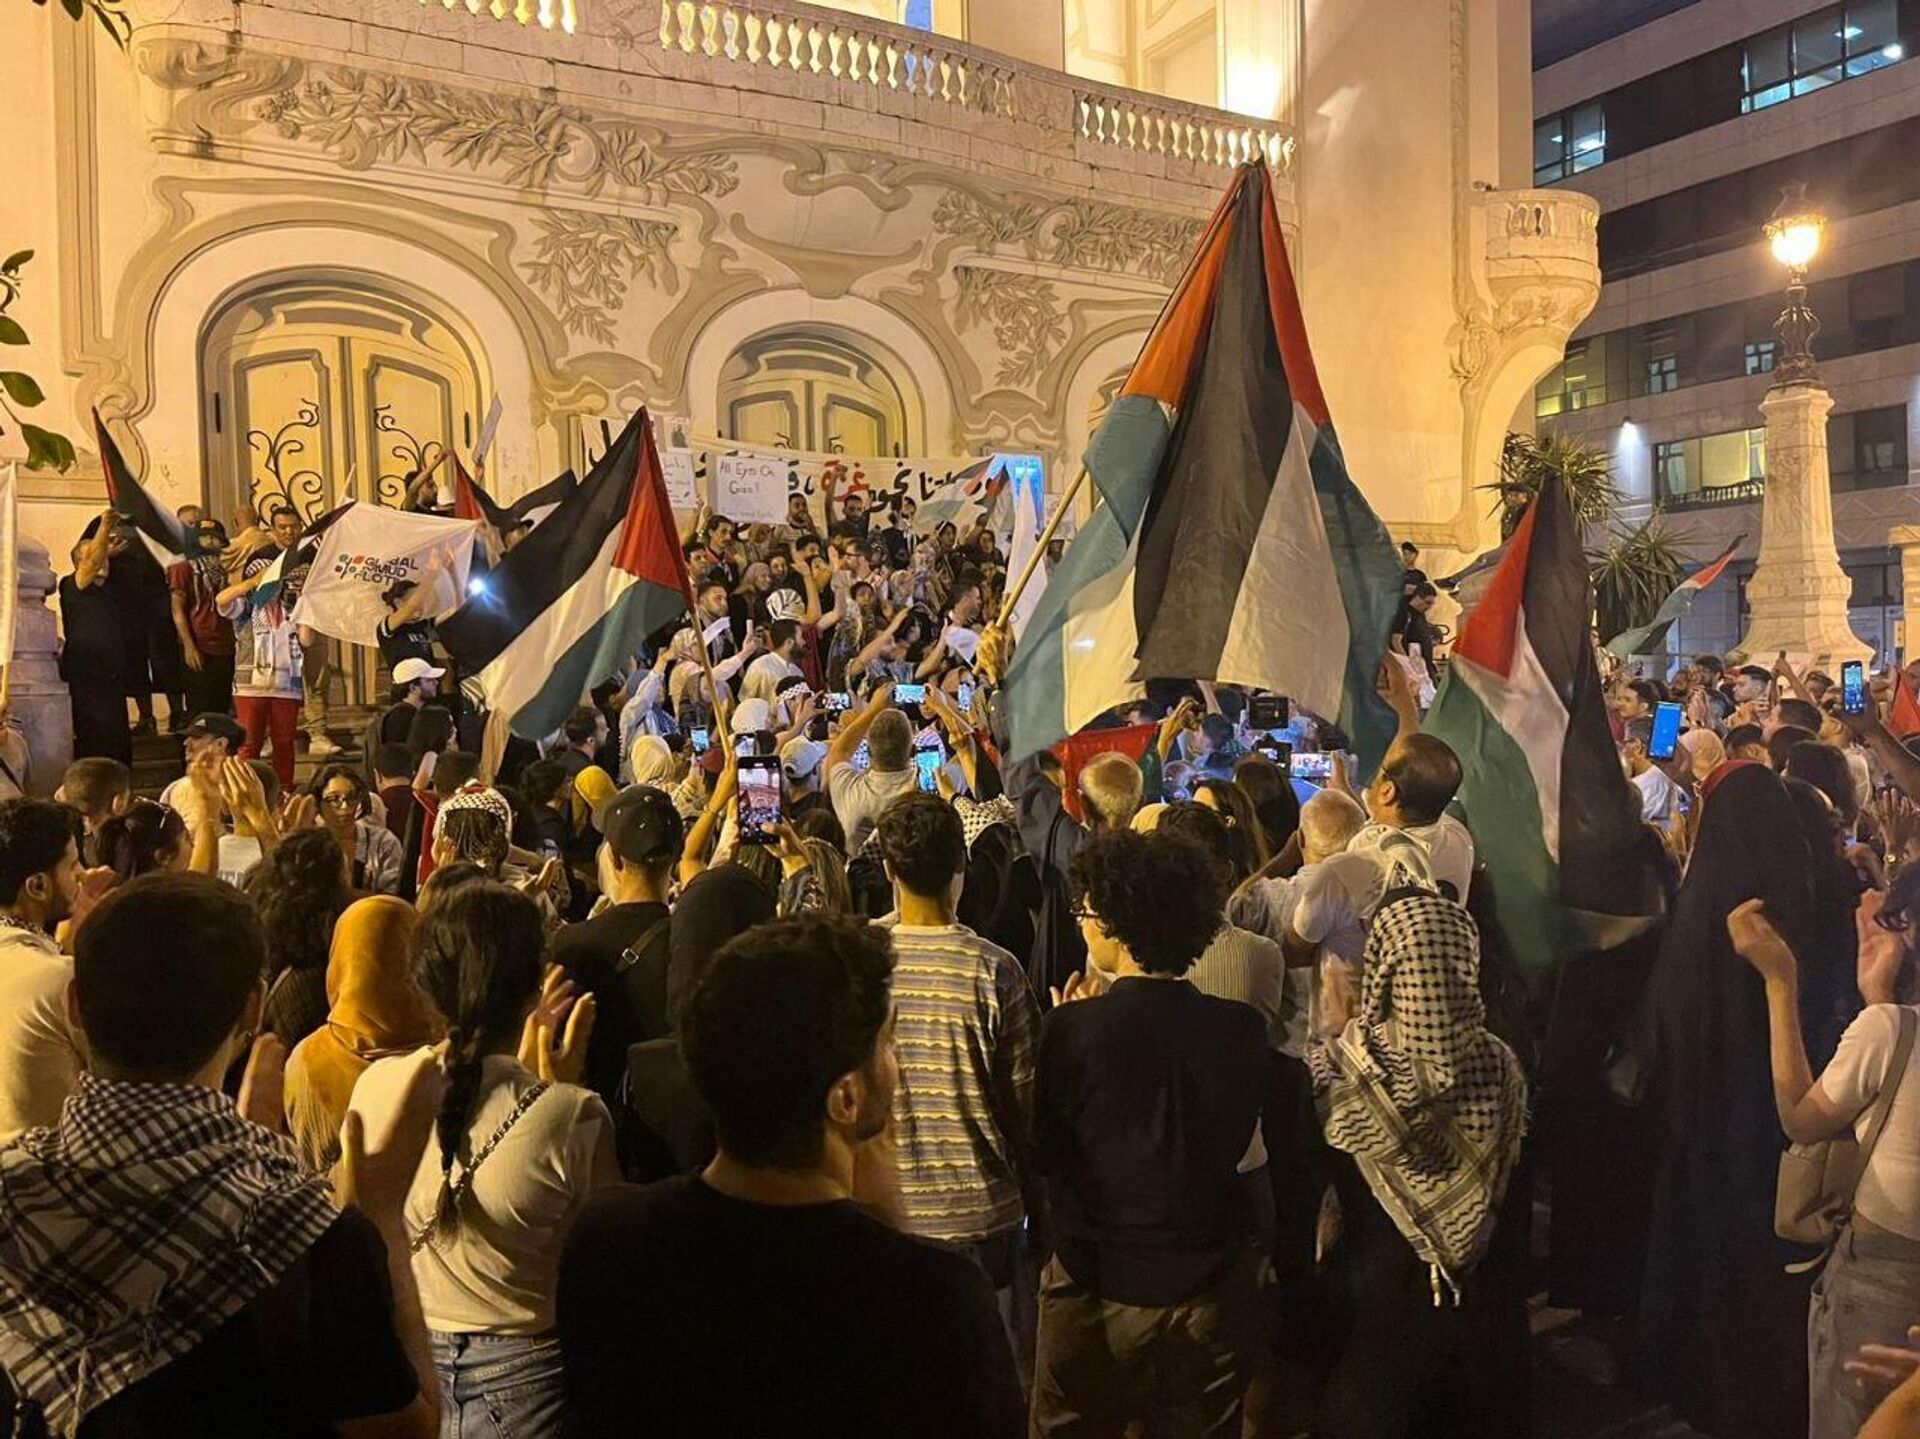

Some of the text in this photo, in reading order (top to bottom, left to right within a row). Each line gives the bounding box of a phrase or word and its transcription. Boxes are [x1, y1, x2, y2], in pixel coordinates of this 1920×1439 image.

[720, 460, 731, 474] All
[735, 462, 757, 480] Eyes
[364, 556, 419, 570] GLBAL
